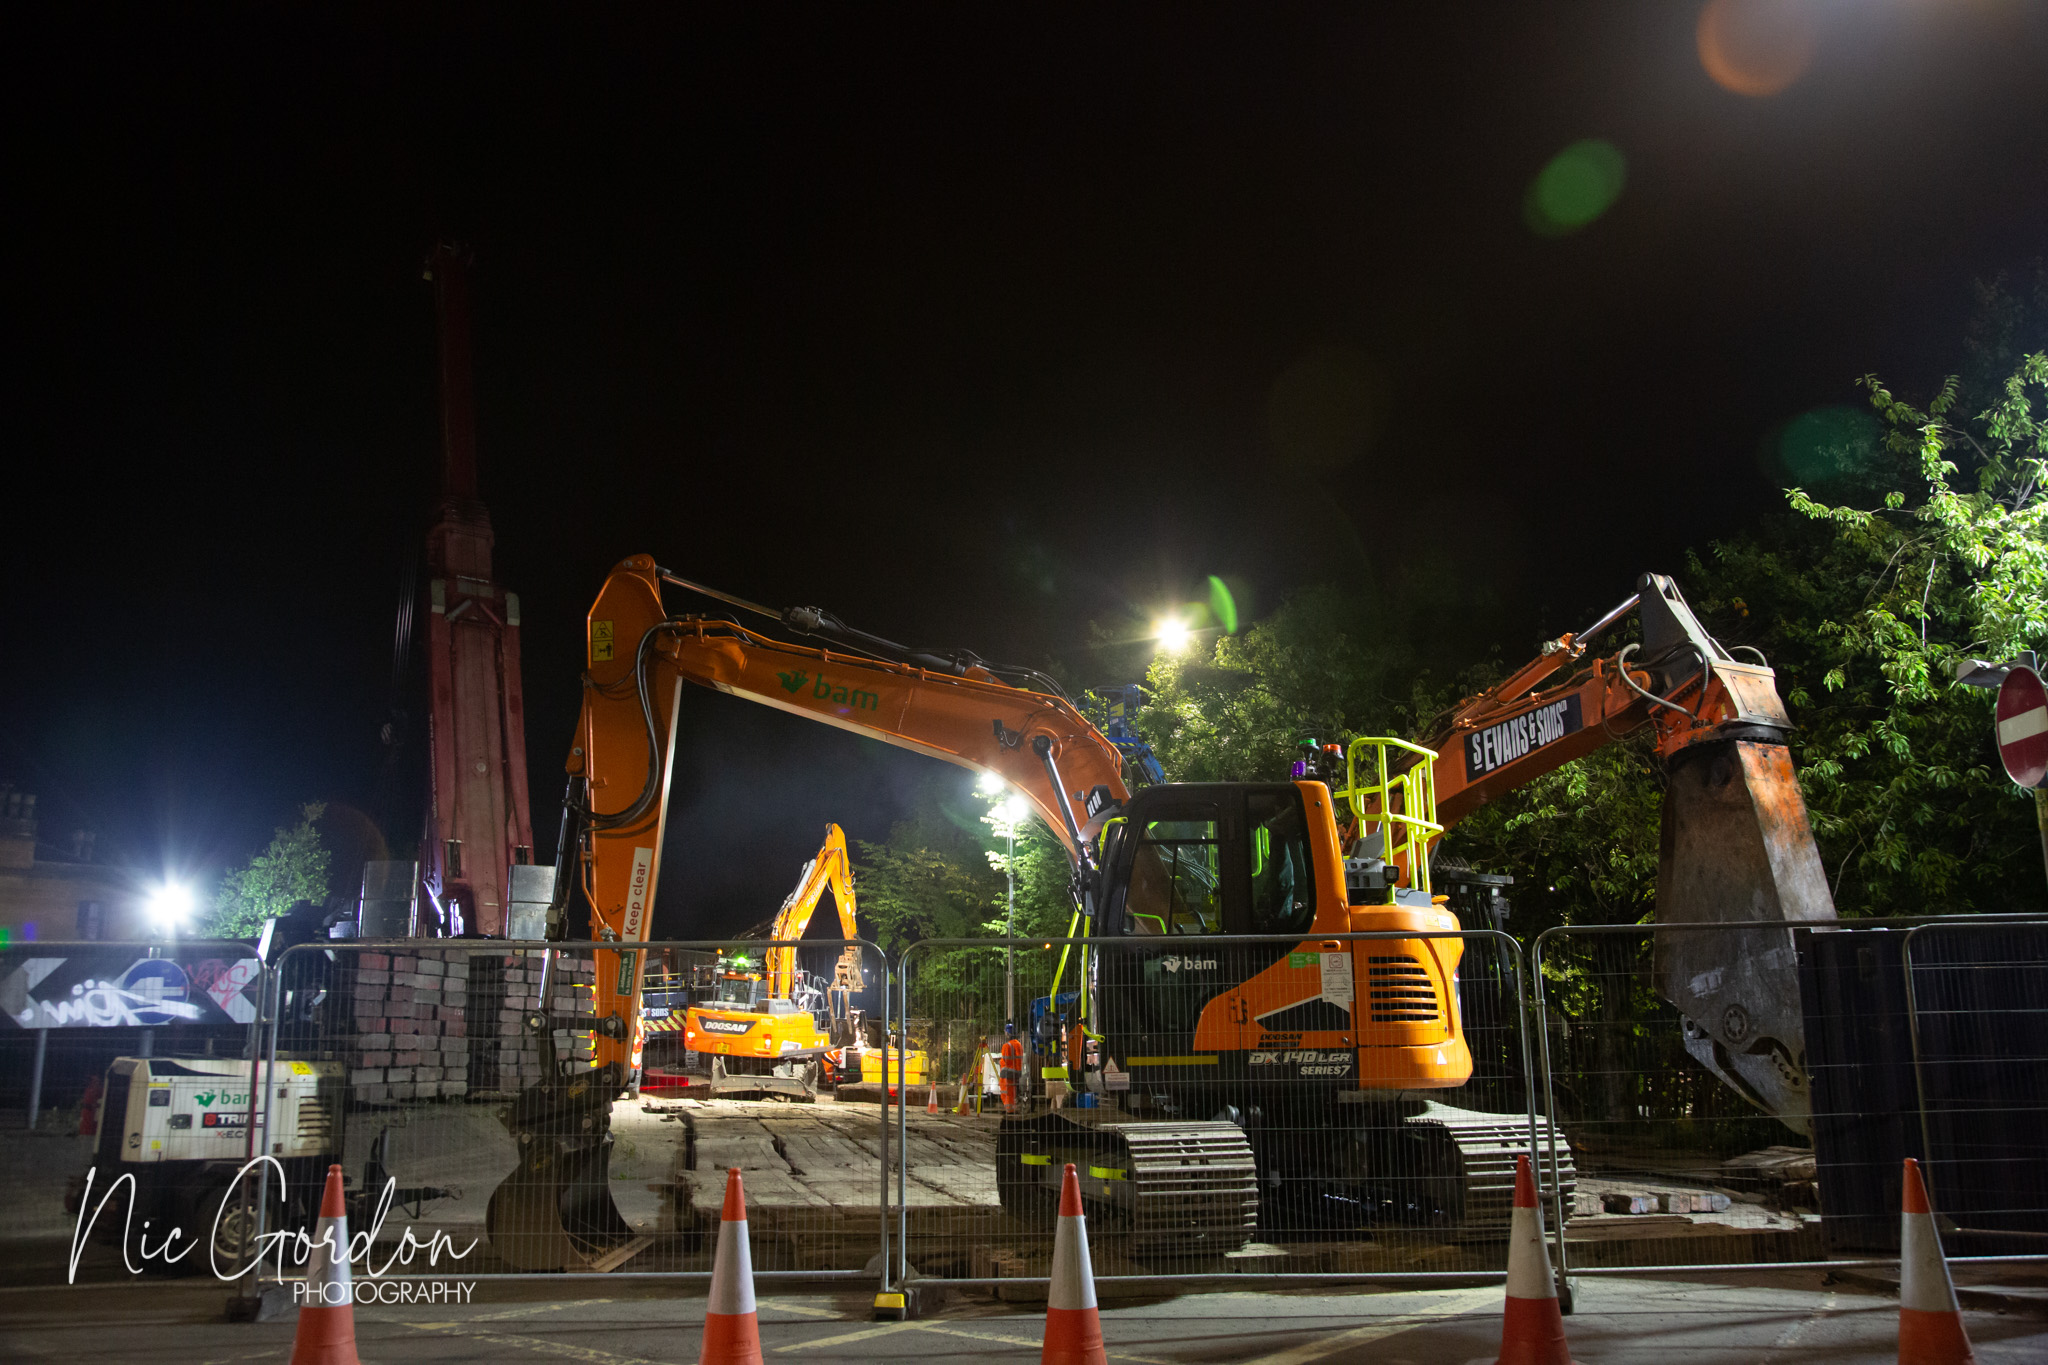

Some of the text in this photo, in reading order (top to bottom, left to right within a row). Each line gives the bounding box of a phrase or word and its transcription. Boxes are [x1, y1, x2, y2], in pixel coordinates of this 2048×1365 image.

[813, 673, 879, 711] bam
[1483, 715, 1530, 772] EVANS
[1528, 712, 1537, 745] &
[1536, 702, 1565, 746] SONS
[625, 862, 647, 936] Keep clear
[1184, 956, 1218, 970] bam
[651, 1008, 669, 1017] SONS
[705, 1021, 748, 1033] DOOSAN
[1260, 1033, 1303, 1041] DOOSAN
[1248, 1051, 1281, 1065] DX
